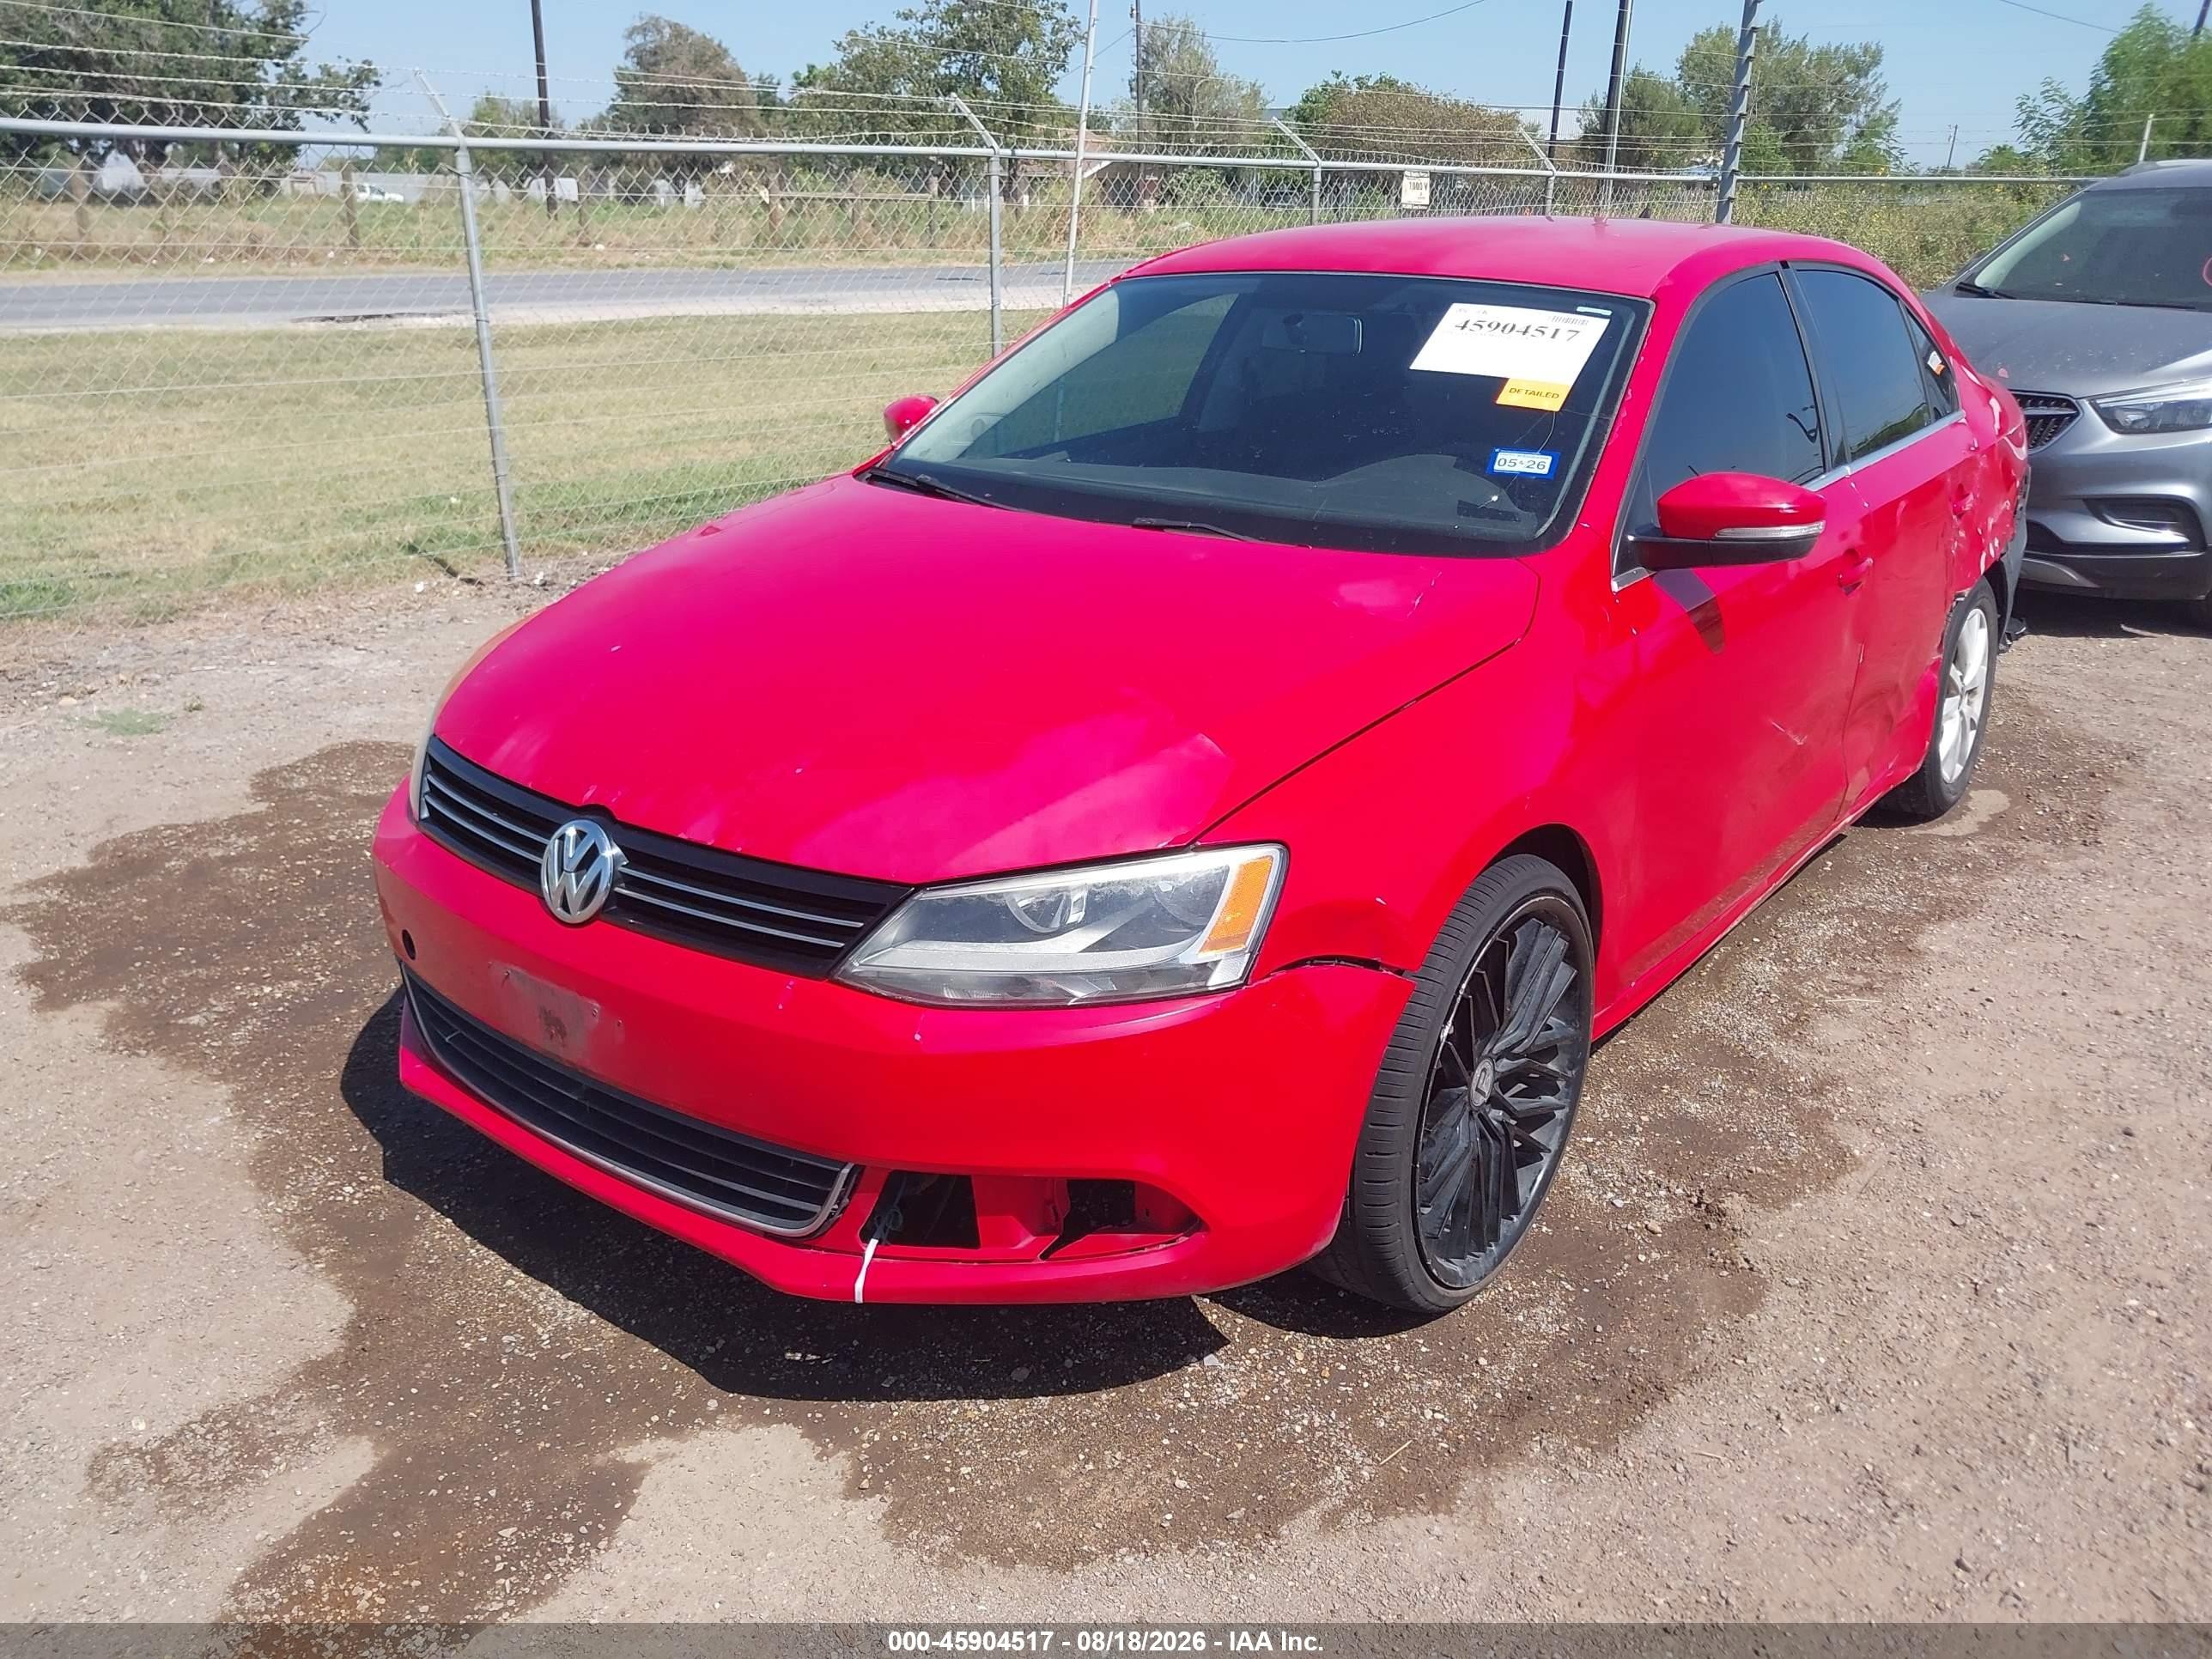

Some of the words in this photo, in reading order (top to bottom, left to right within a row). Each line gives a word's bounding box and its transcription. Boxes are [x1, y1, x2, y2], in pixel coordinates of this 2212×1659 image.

[1454, 318, 1581, 342] 45904517
[1508, 386, 1559, 400] DETAILED
[1498, 458, 1518, 468] 05
[1525, 459, 1547, 471] 26
